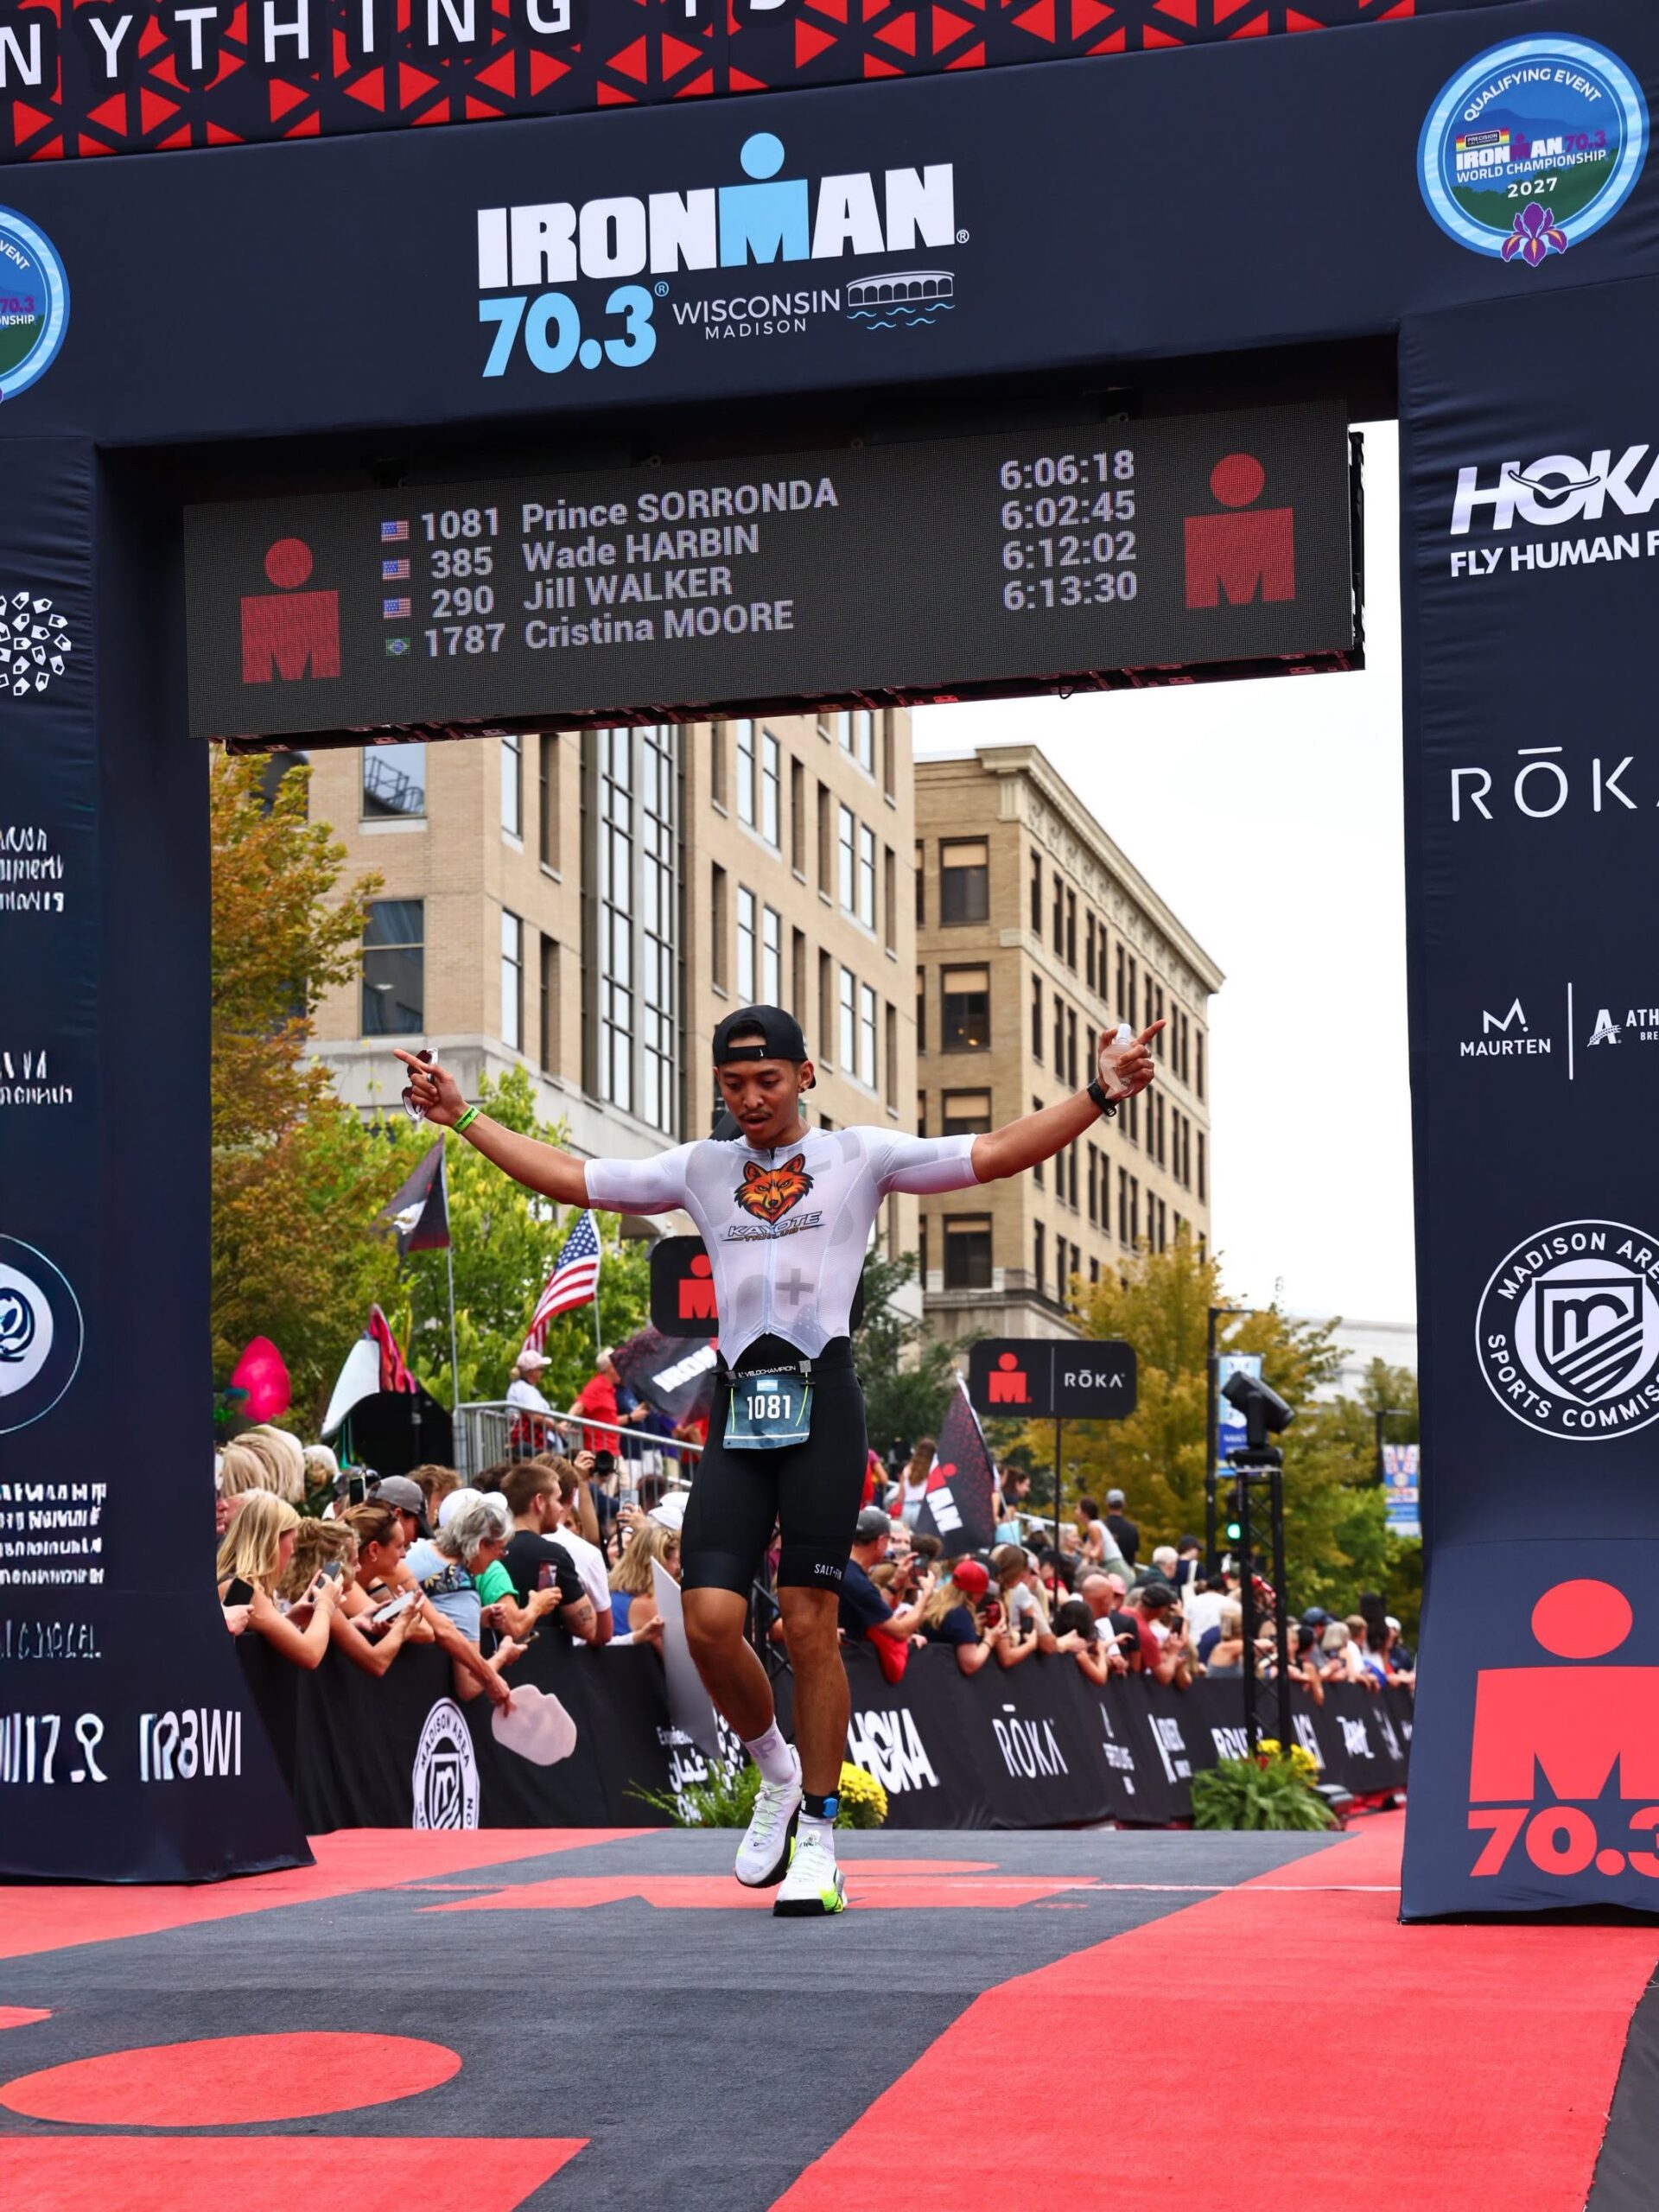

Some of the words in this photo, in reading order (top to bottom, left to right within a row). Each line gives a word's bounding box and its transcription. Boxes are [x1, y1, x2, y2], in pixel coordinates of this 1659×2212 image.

[1464, 68, 1552, 122] QUALIFYING
[1554, 69, 1602, 103] EVENT
[1456, 133, 1564, 171] IRONMAN
[1565, 130, 1607, 154] 70.3
[1457, 166, 1503, 183] WORLD
[1506, 149, 1606, 175] CHAMPIONSHIP
[1507, 177, 1558, 198] 2027
[672, 289, 841, 326] WISCONSIN
[705, 319, 807, 340] MADISON
[1000, 449, 1135, 491] 6:06:18
[1450, 444, 1659, 535] HOK
[422, 507, 499, 541] 1081
[522, 499, 628, 533] Prince
[637, 478, 838, 524] SORRONDA
[1001, 490, 1136, 531] 6:02:45
[431, 546, 493, 579] 385
[523, 537, 616, 572] Wade
[626, 524, 760, 563] HARBIN
[1001, 531, 1137, 570] 6:12:02
[1450, 547, 1504, 578] FLY
[1510, 532, 1640, 571] HUMAN
[432, 586, 494, 618] 290
[524, 576, 576, 611] Jill
[585, 566, 734, 606] WALKER
[1003, 571, 1138, 610] 6:13:30
[424, 623, 506, 657] 1787
[524, 613, 655, 650] Cristina
[664, 600, 795, 639] MOORE
[1460, 1039, 1551, 1057] MAURTEN
[728, 1211, 823, 1237] KAYOTE
[1497, 1232, 1605, 1300] MADISON
[745, 1366, 797, 1377] VELOCHAMPION
[1488, 1334, 1552, 1418] SPORTS
[1562, 1371, 1659, 1428] COMMIS
[747, 1395, 791, 1421] 1081
[452, 1721, 470, 1769] AREA
